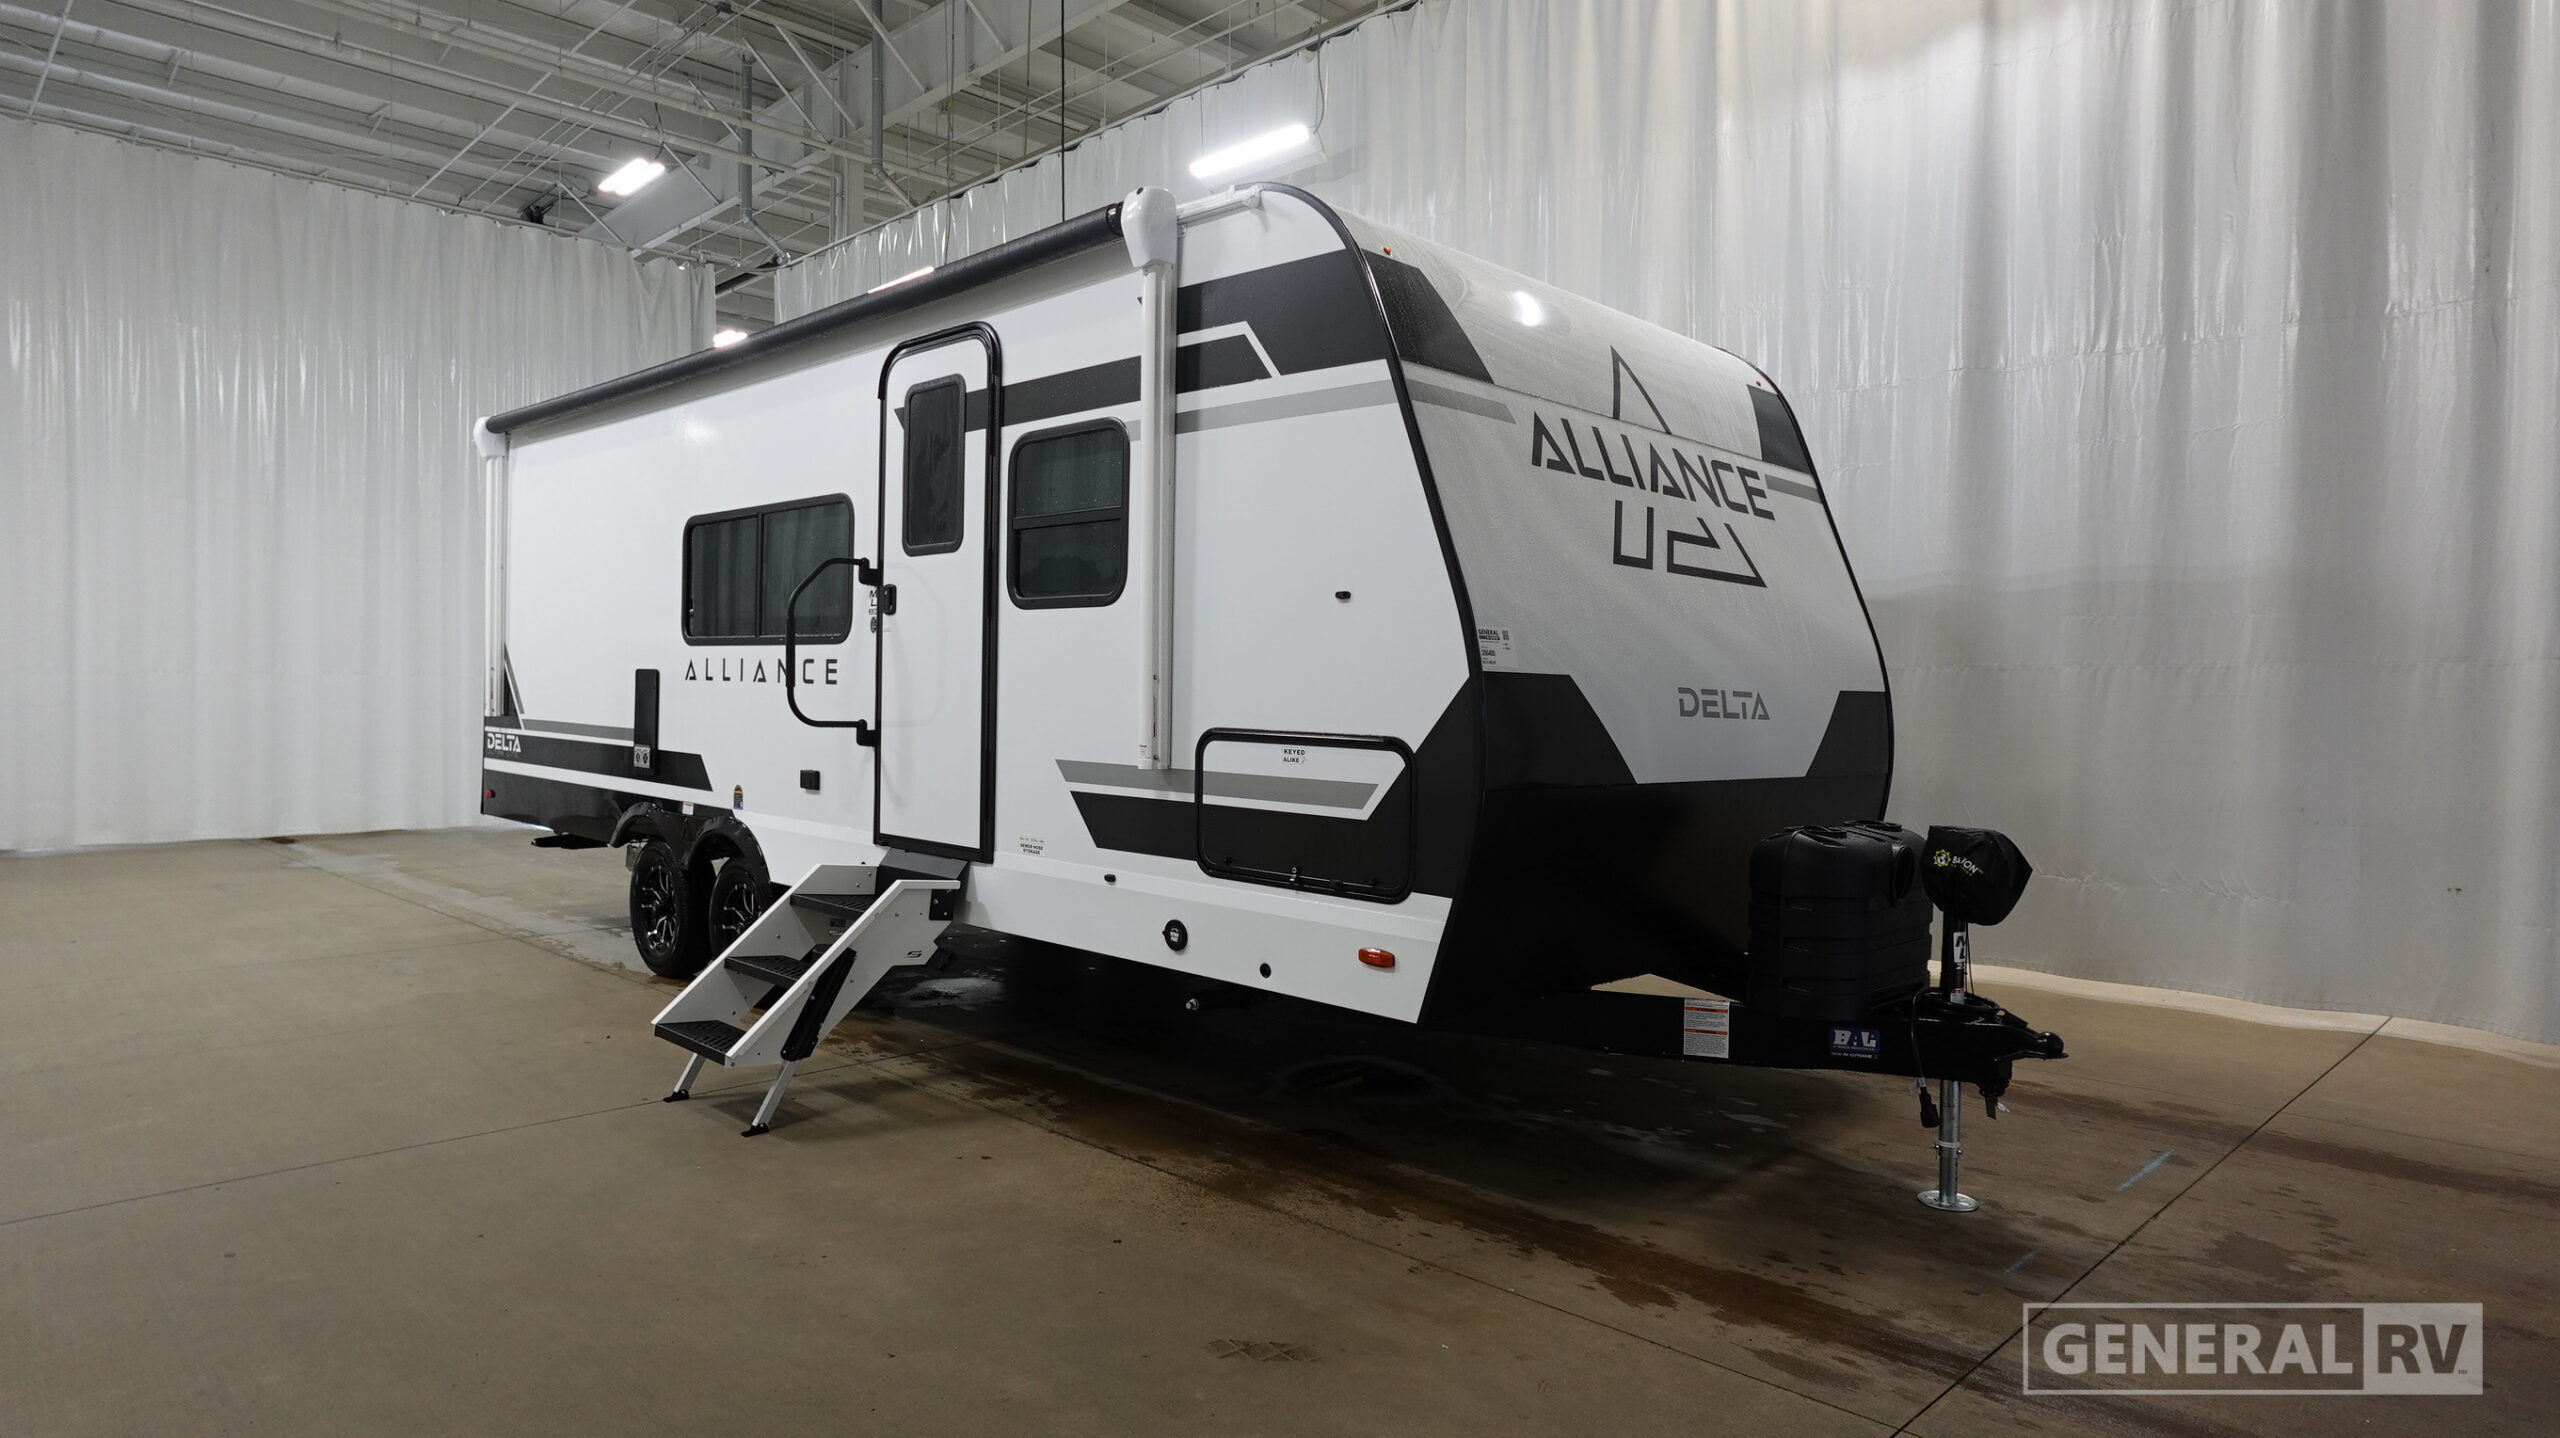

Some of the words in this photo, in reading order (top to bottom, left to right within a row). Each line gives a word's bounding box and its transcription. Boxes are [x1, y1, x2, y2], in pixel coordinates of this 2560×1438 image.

[1531, 411, 1775, 521] ALLIANCE
[1678, 687, 1770, 720] DELTA
[487, 732, 522, 752] DELTA
[1283, 748, 1306, 756] KEYED
